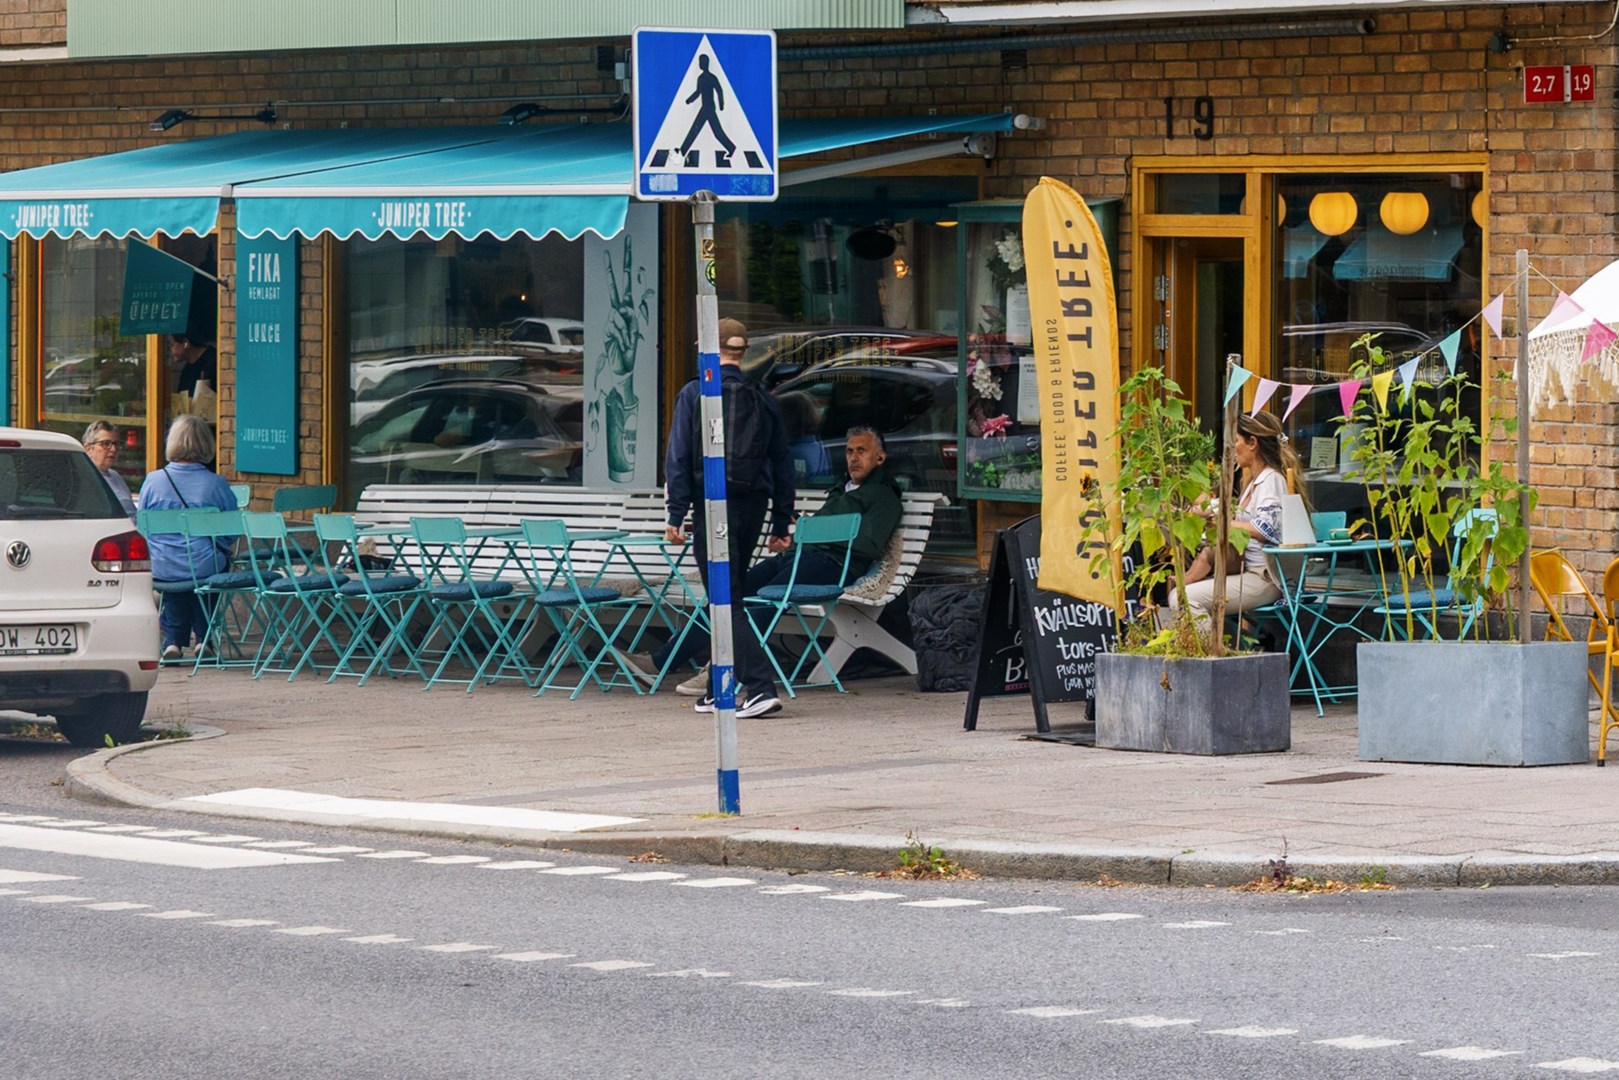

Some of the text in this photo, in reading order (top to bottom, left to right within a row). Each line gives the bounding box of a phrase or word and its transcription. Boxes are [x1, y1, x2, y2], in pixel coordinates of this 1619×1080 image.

[1532, 73, 1591, 95] 2,7 1,9
[1164, 96, 1214, 141] 19
[16, 204, 90, 228] JUNIPER TREE
[377, 202, 466, 227] JUNIPER TREE
[248, 252, 281, 283] FIKA
[248, 287, 281, 300] HEMLAGAT
[129, 300, 182, 321] ÖPPET
[850, 336, 893, 368] TREE
[270, 428, 287, 444] TREE
[105, 579, 120, 588] TDI
[35, 627, 72, 647] 402
[1056, 662, 1096, 680] PLUS MAS
[1064, 677, 1084, 692] GODA
